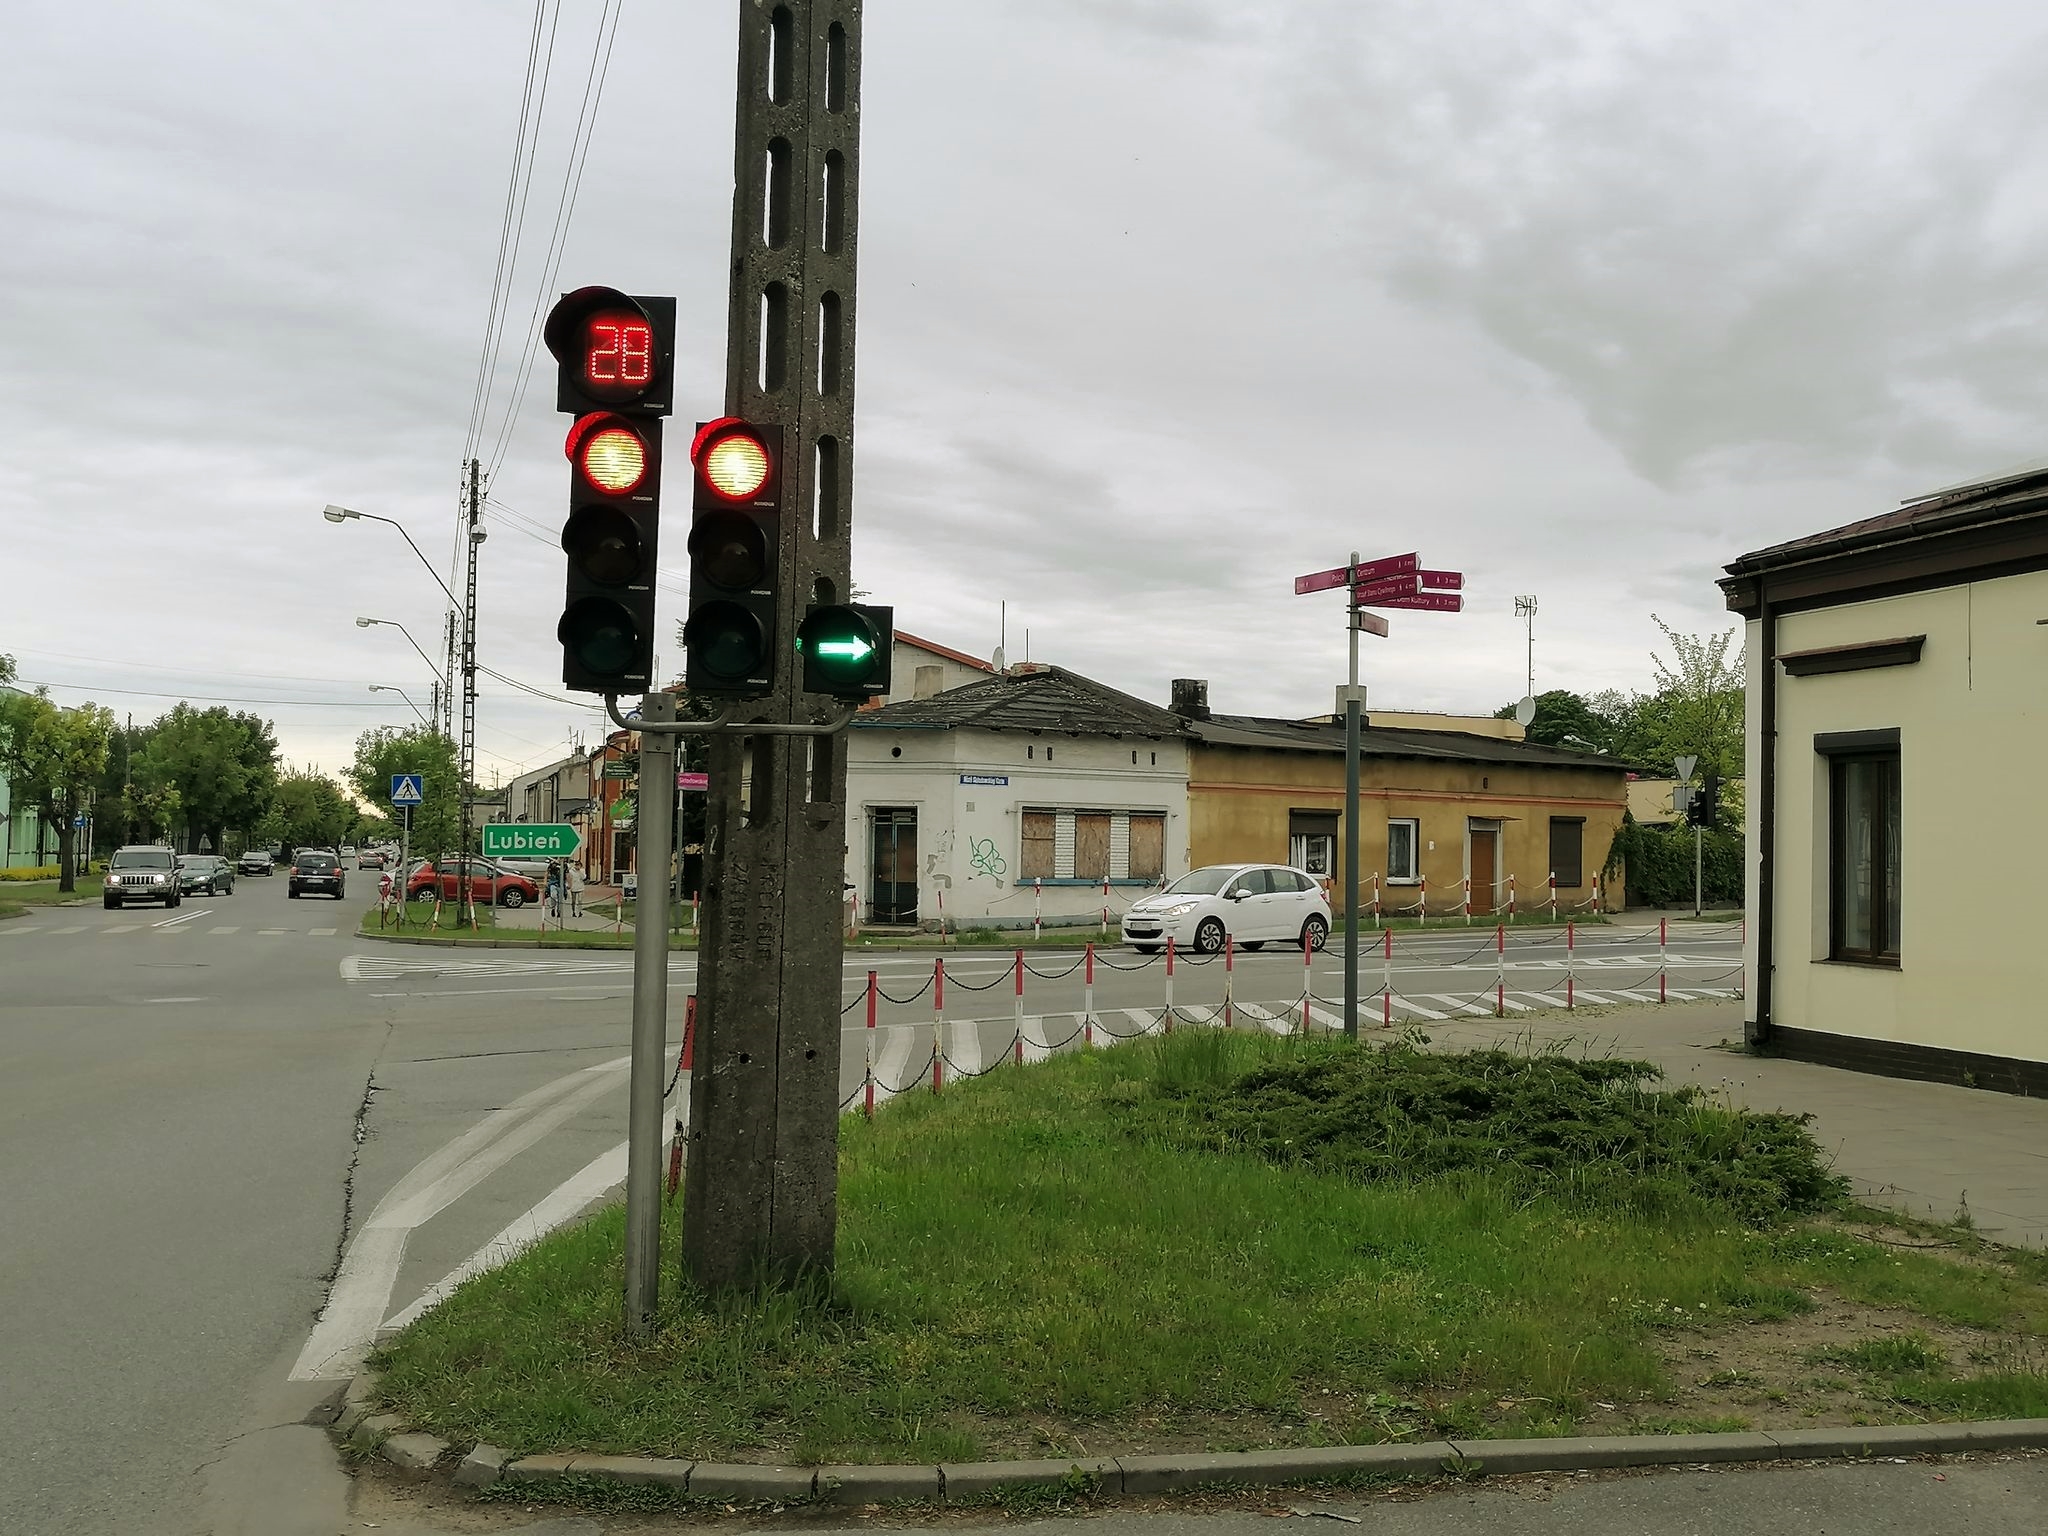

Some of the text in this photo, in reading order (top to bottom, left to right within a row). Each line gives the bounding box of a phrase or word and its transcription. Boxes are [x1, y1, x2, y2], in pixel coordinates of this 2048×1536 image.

[592, 325, 649, 380] 28
[1357, 567, 1376, 578] Centrum
[1411, 597, 1430, 606] Kultury
[489, 831, 561, 849] Lubień
